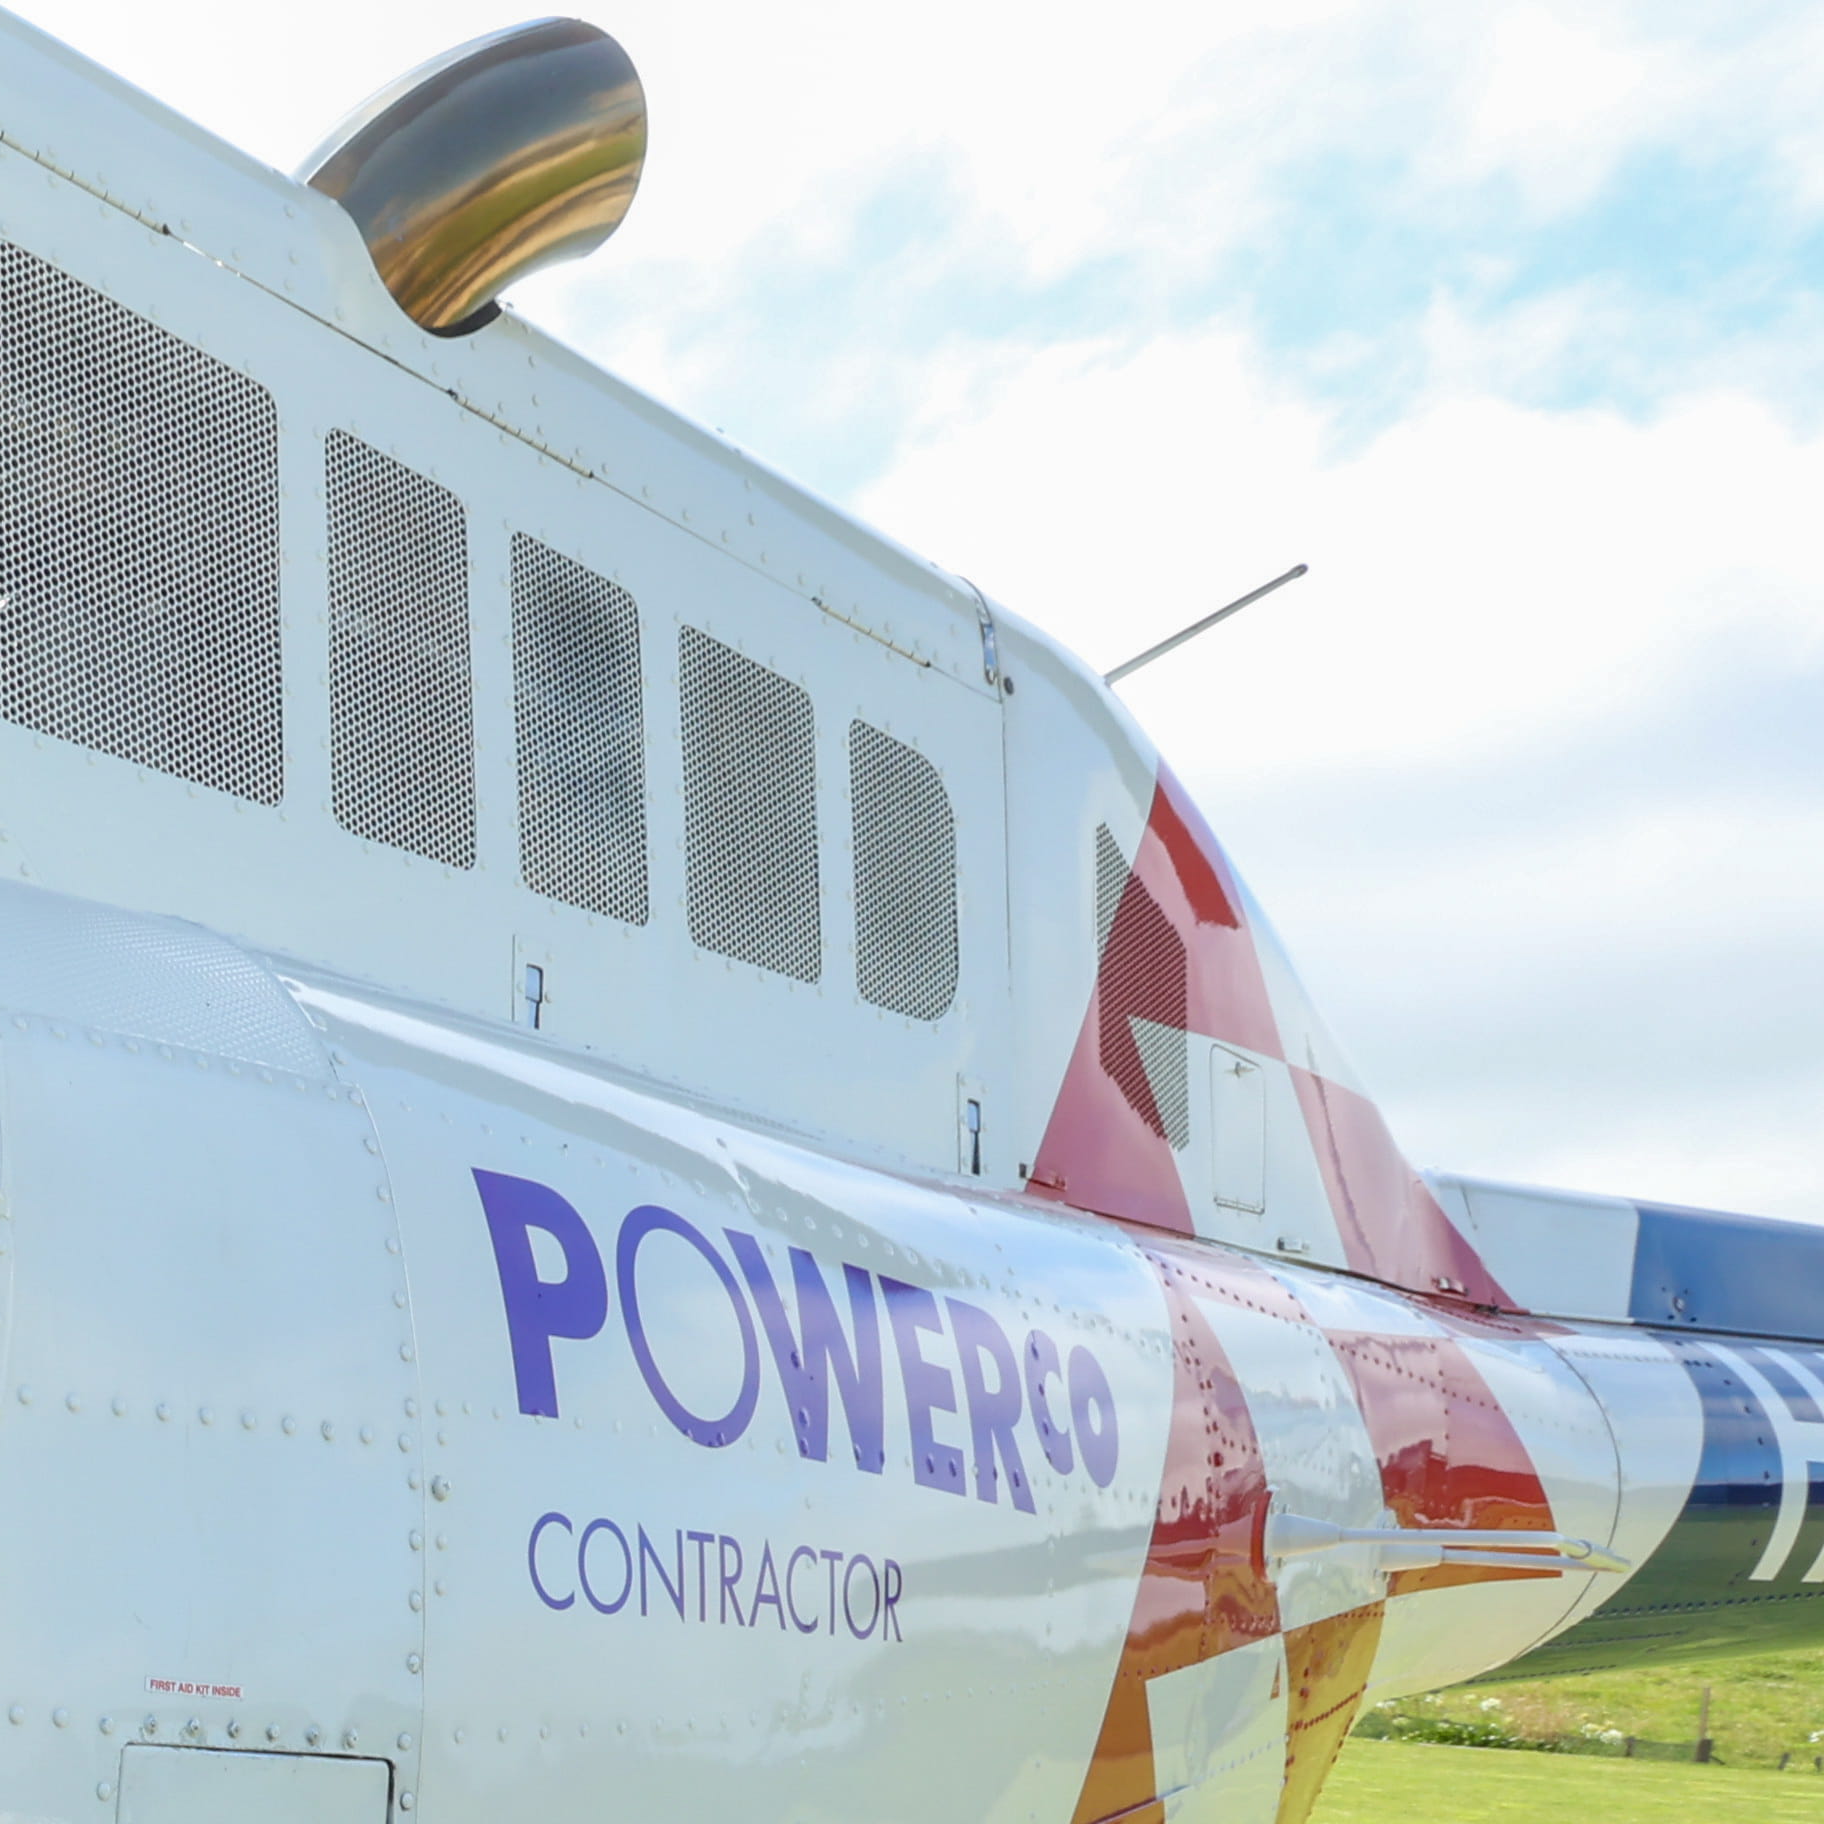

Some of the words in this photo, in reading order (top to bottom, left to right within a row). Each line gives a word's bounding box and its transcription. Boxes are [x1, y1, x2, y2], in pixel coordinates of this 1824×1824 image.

[527, 1511, 903, 1643] CONTRACTOR
[150, 1679, 176, 1692] FIRST
[178, 1682, 194, 1694] AID
[196, 1684, 210, 1695] KIT
[212, 1686, 241, 1698] INSIDE
